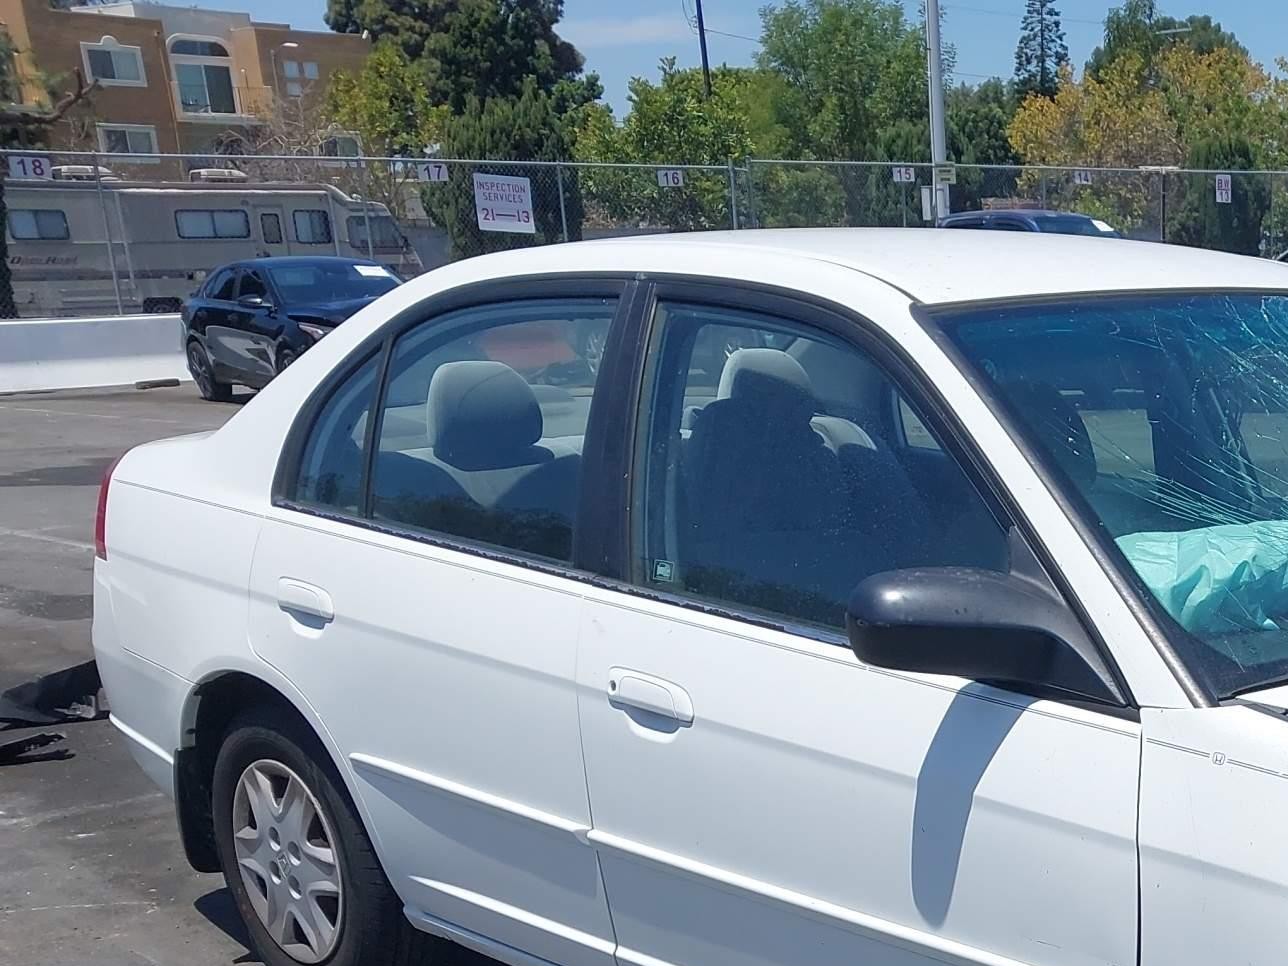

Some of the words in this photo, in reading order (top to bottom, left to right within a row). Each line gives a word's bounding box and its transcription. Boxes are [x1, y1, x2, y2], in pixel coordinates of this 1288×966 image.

[17, 158, 45, 176] 18
[424, 165, 442, 180] 17
[663, 172, 680, 185] 16
[896, 168, 912, 180] 15
[1078, 172, 1089, 182] 14
[475, 181, 526, 193] INSPECTION
[482, 192, 524, 204] SERVICES
